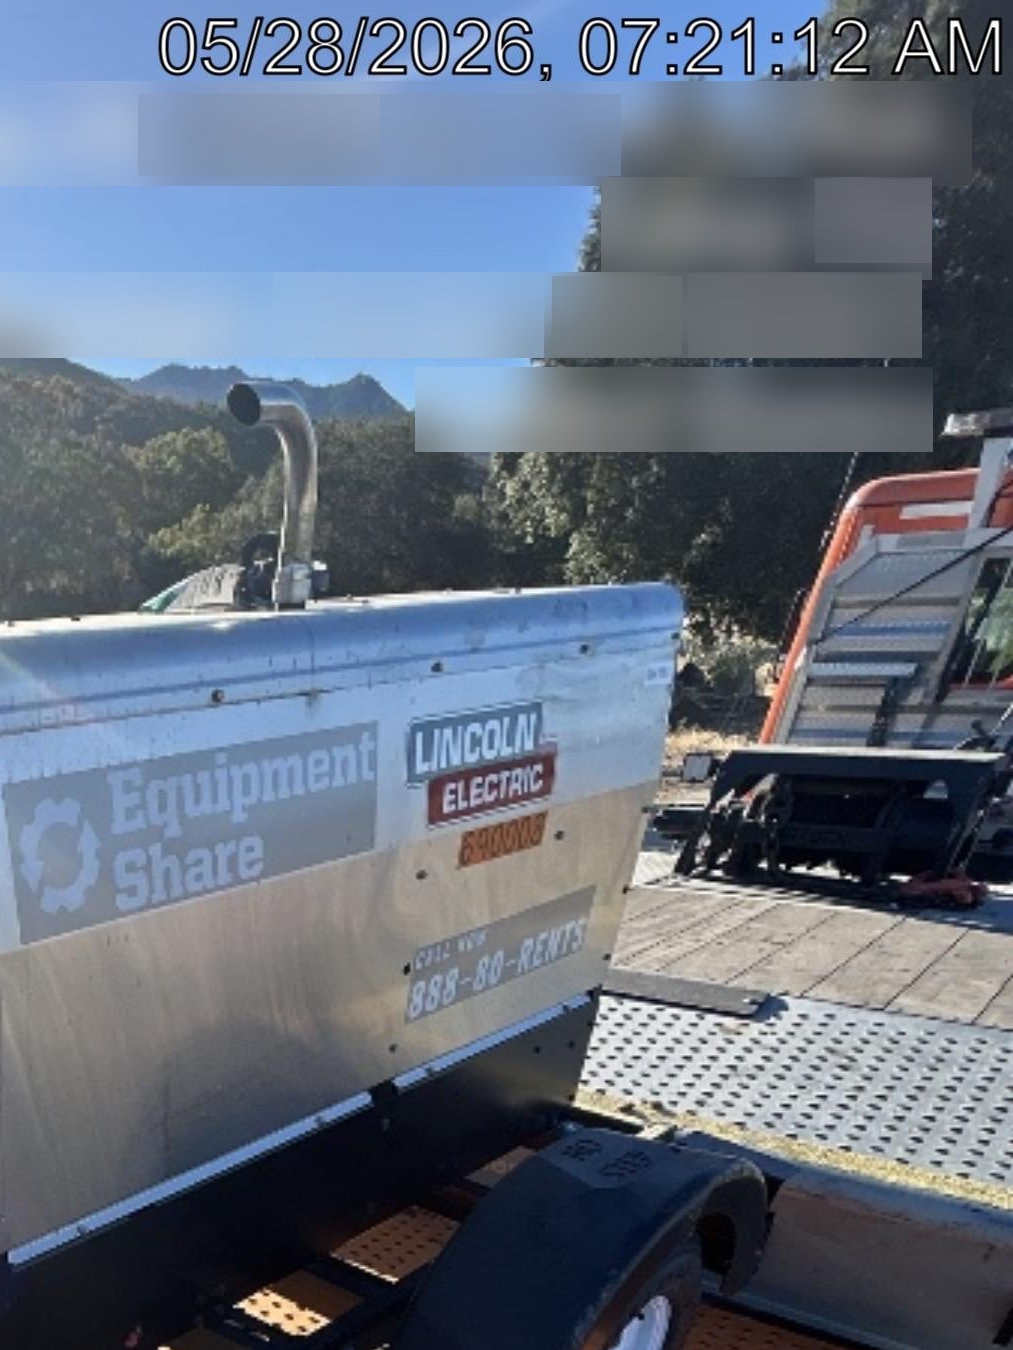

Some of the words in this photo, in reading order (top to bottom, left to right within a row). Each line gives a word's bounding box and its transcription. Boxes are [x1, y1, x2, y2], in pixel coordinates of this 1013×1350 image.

[415, 712, 537, 775] LINCOLN
[107, 730, 376, 840] Equipment
[442, 763, 544, 815] ELECTRIC
[112, 834, 264, 911] Share
